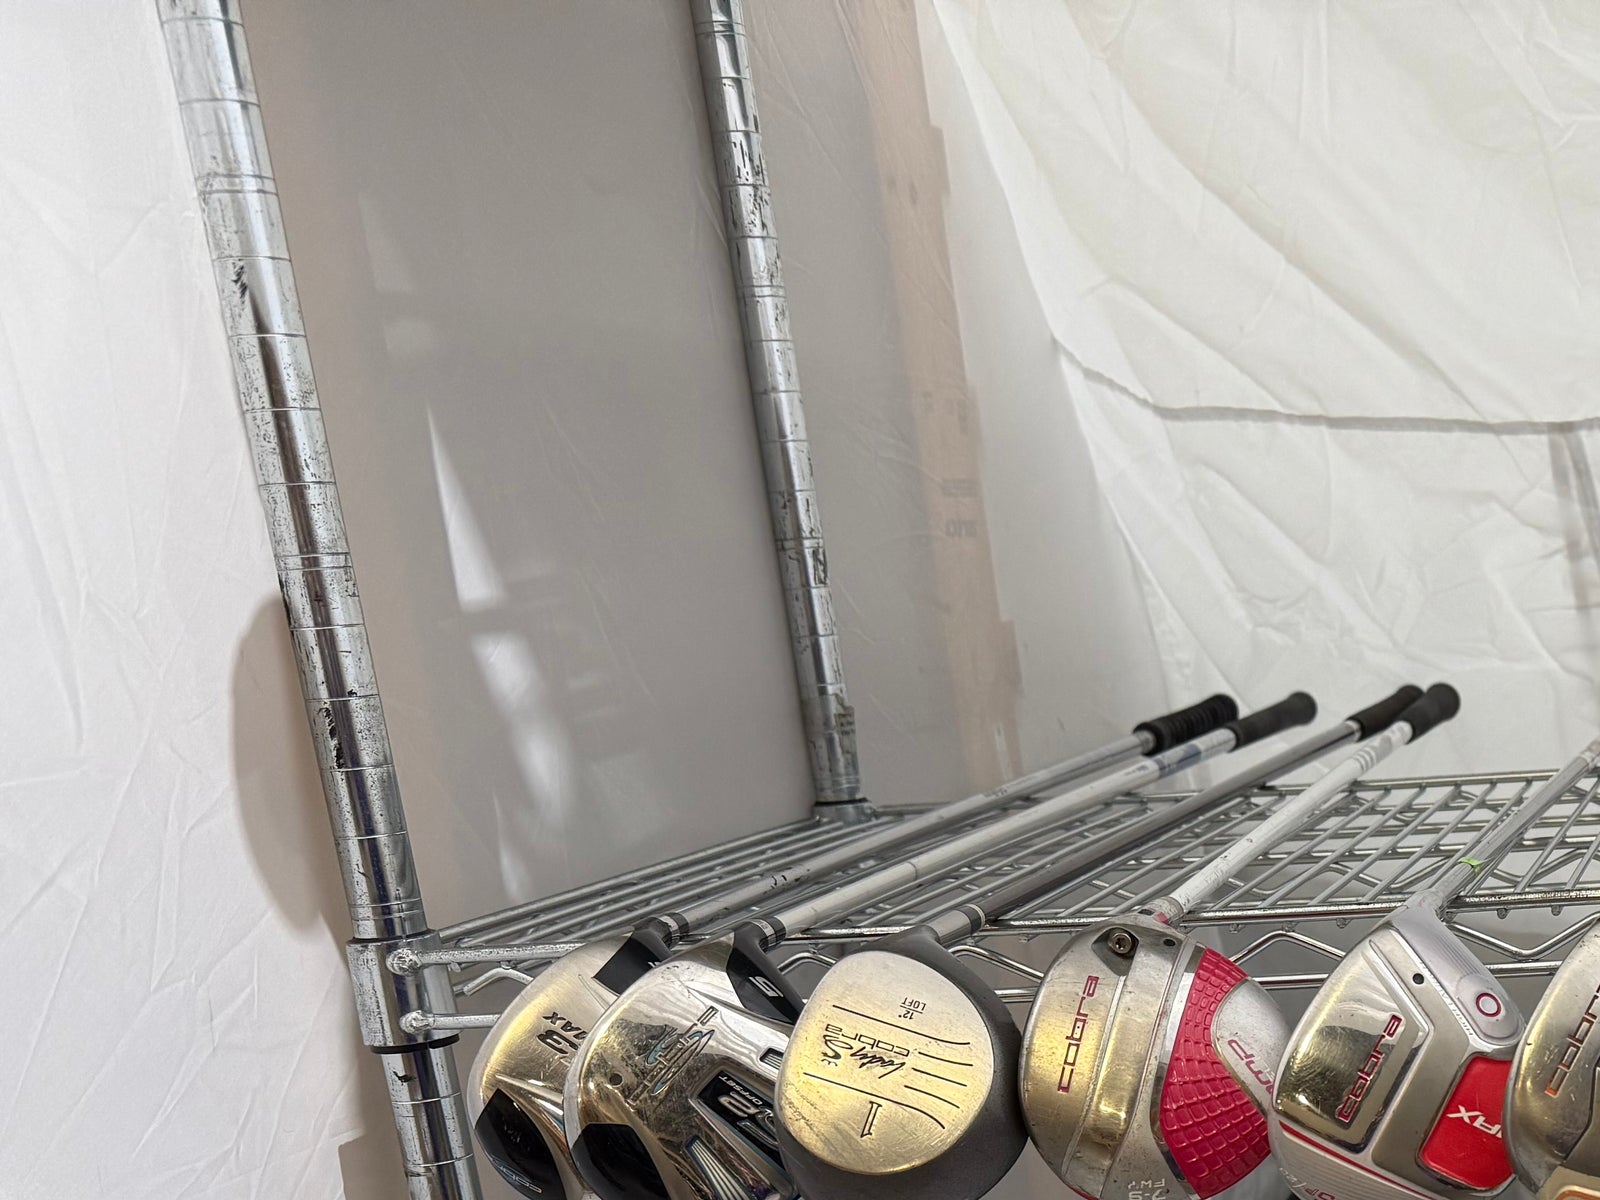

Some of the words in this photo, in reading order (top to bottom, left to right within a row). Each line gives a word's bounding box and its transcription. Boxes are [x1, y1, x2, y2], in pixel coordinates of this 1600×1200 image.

[748, 975, 784, 998] 5
[901, 997, 927, 1011] LOFT
[825, 1023, 911, 1058] cobra
[1058, 976, 1100, 1094] cobra
[850, 1046, 906, 1079] Lady
[1334, 1013, 1403, 1123] cobra
[718, 1075, 764, 1106] OFFSET
[860, 1100, 883, 1138] 1
